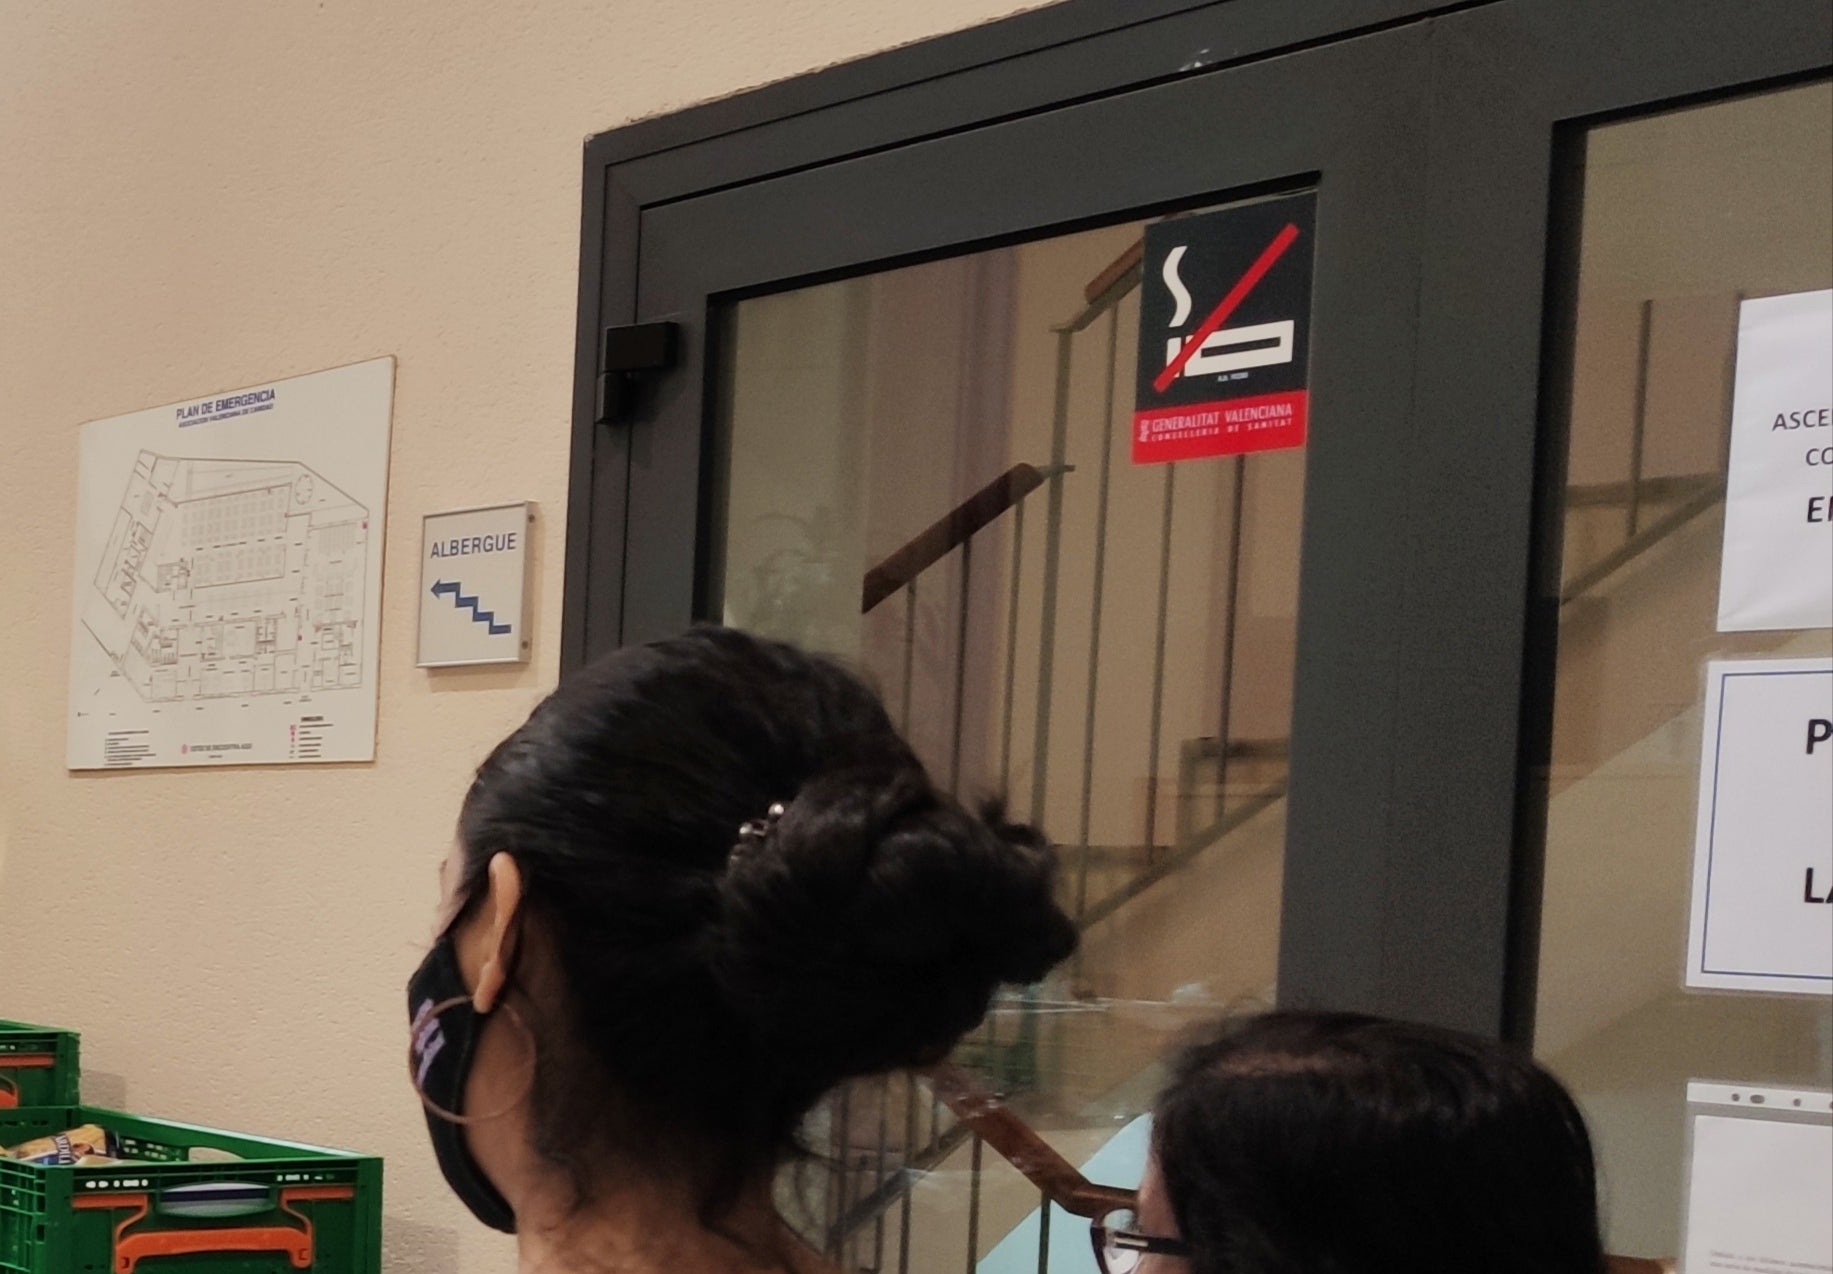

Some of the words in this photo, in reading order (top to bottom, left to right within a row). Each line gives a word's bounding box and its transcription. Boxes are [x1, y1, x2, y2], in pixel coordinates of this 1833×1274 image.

[176, 404, 199, 419] PLAN
[201, 401, 213, 414] DE
[216, 388, 275, 411] EMERGENCIA
[1152, 411, 1220, 433] GENERALITAT
[1225, 403, 1293, 423] VALENCIANA
[1227, 424, 1239, 433] DE
[1248, 418, 1293, 431] SANITAT
[1772, 408, 1833, 432] ASCE
[1807, 495, 1833, 523] E
[430, 532, 517, 559] ALBERGUE
